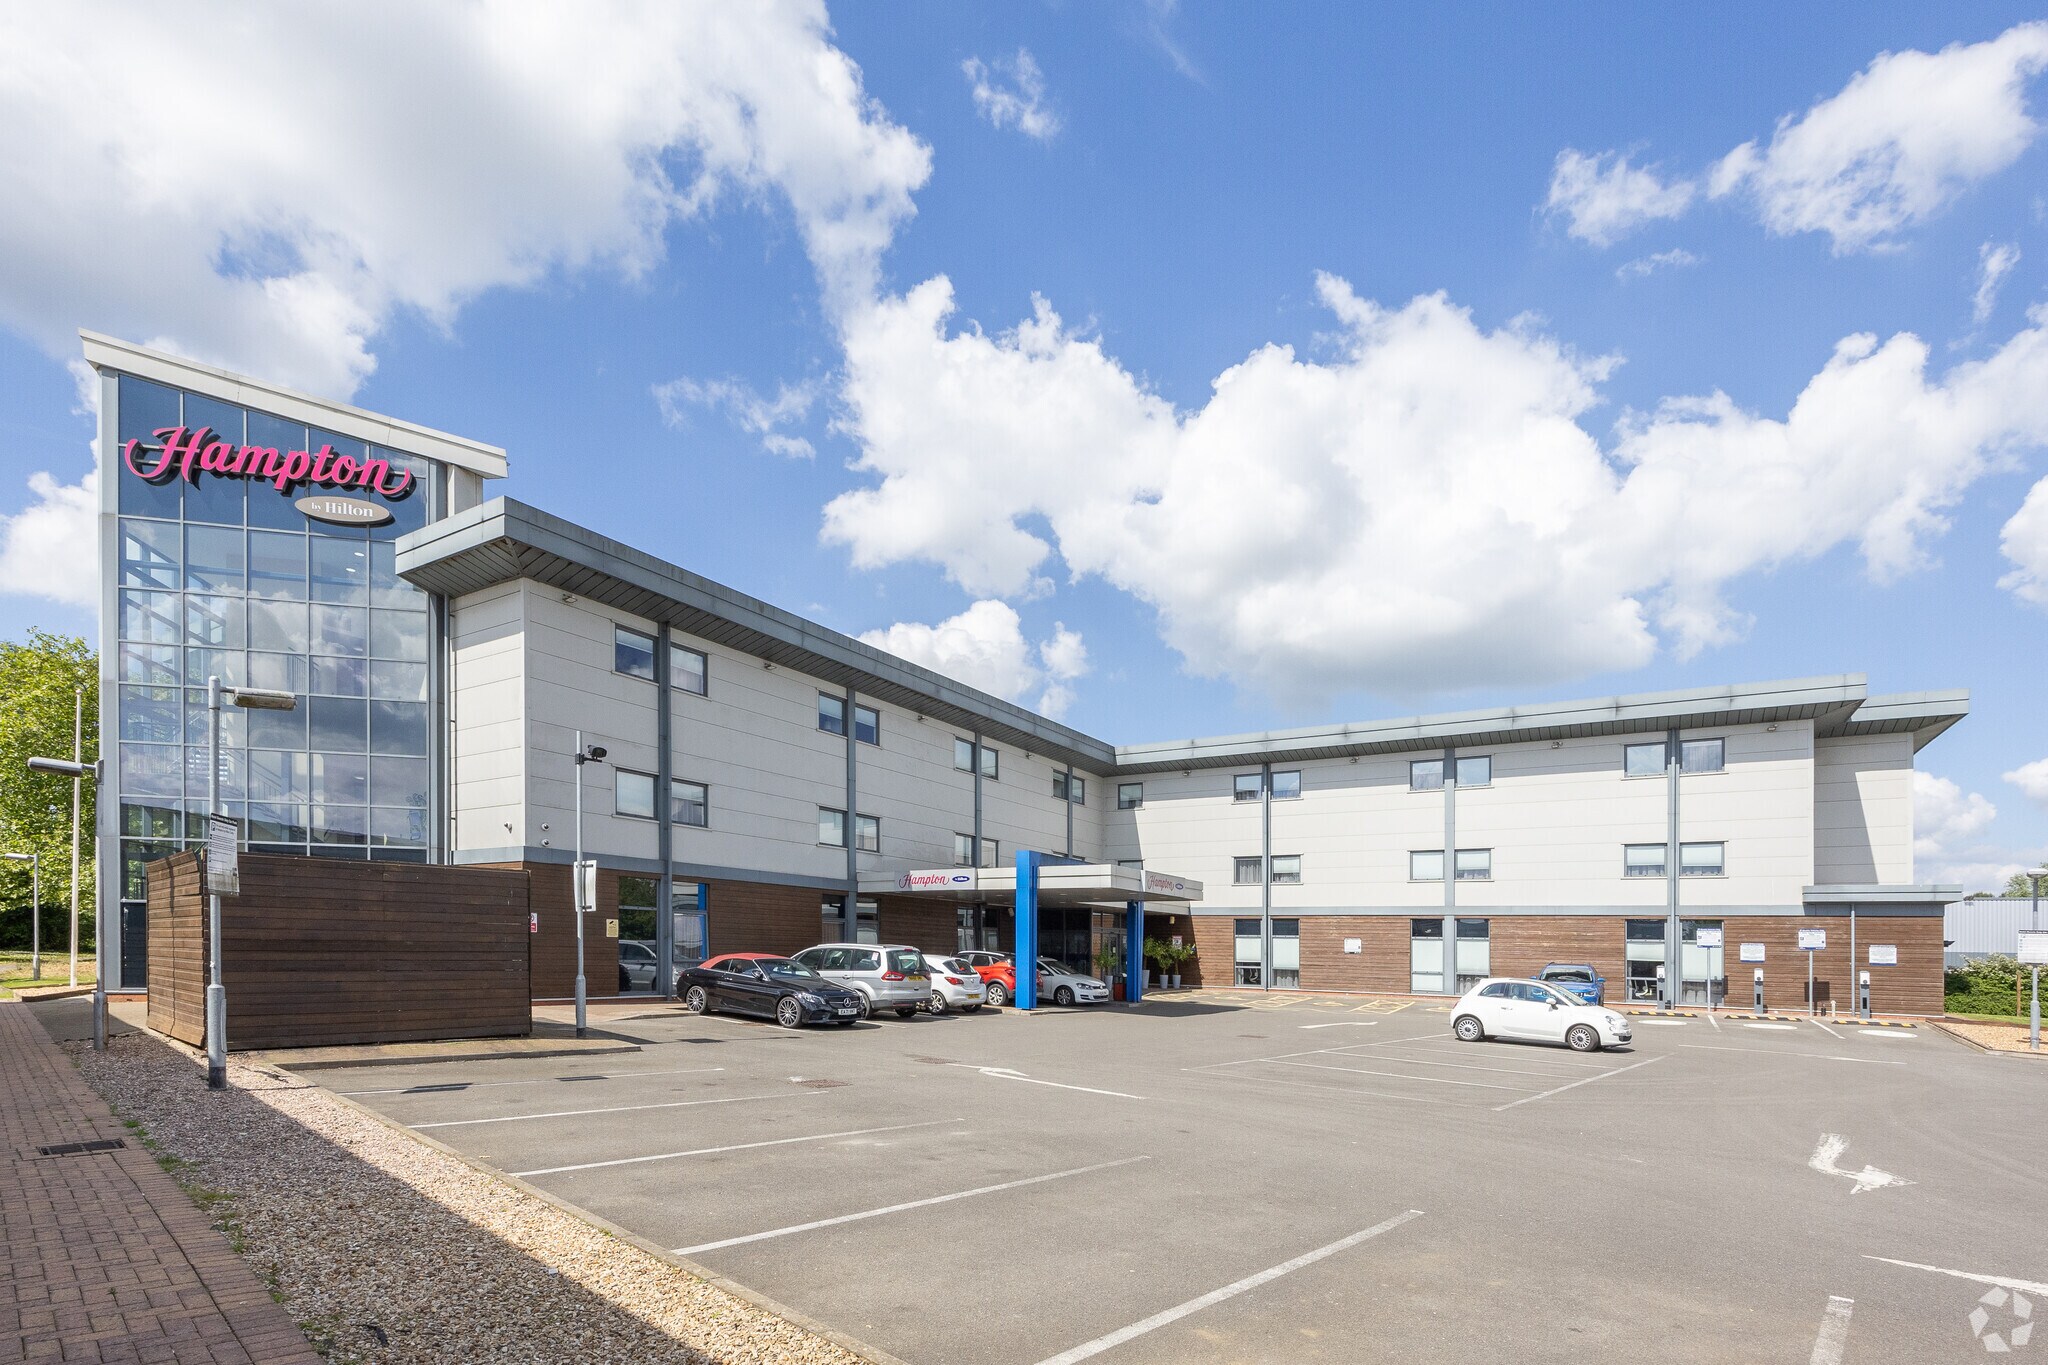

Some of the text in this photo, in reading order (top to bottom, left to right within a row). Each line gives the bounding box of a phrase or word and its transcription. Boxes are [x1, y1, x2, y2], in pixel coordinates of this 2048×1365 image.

[124, 426, 412, 496] Hampton
[311, 501, 374, 517] by Hilton
[898, 874, 949, 888] Hampton
[1147, 875, 1175, 891] Hampton
